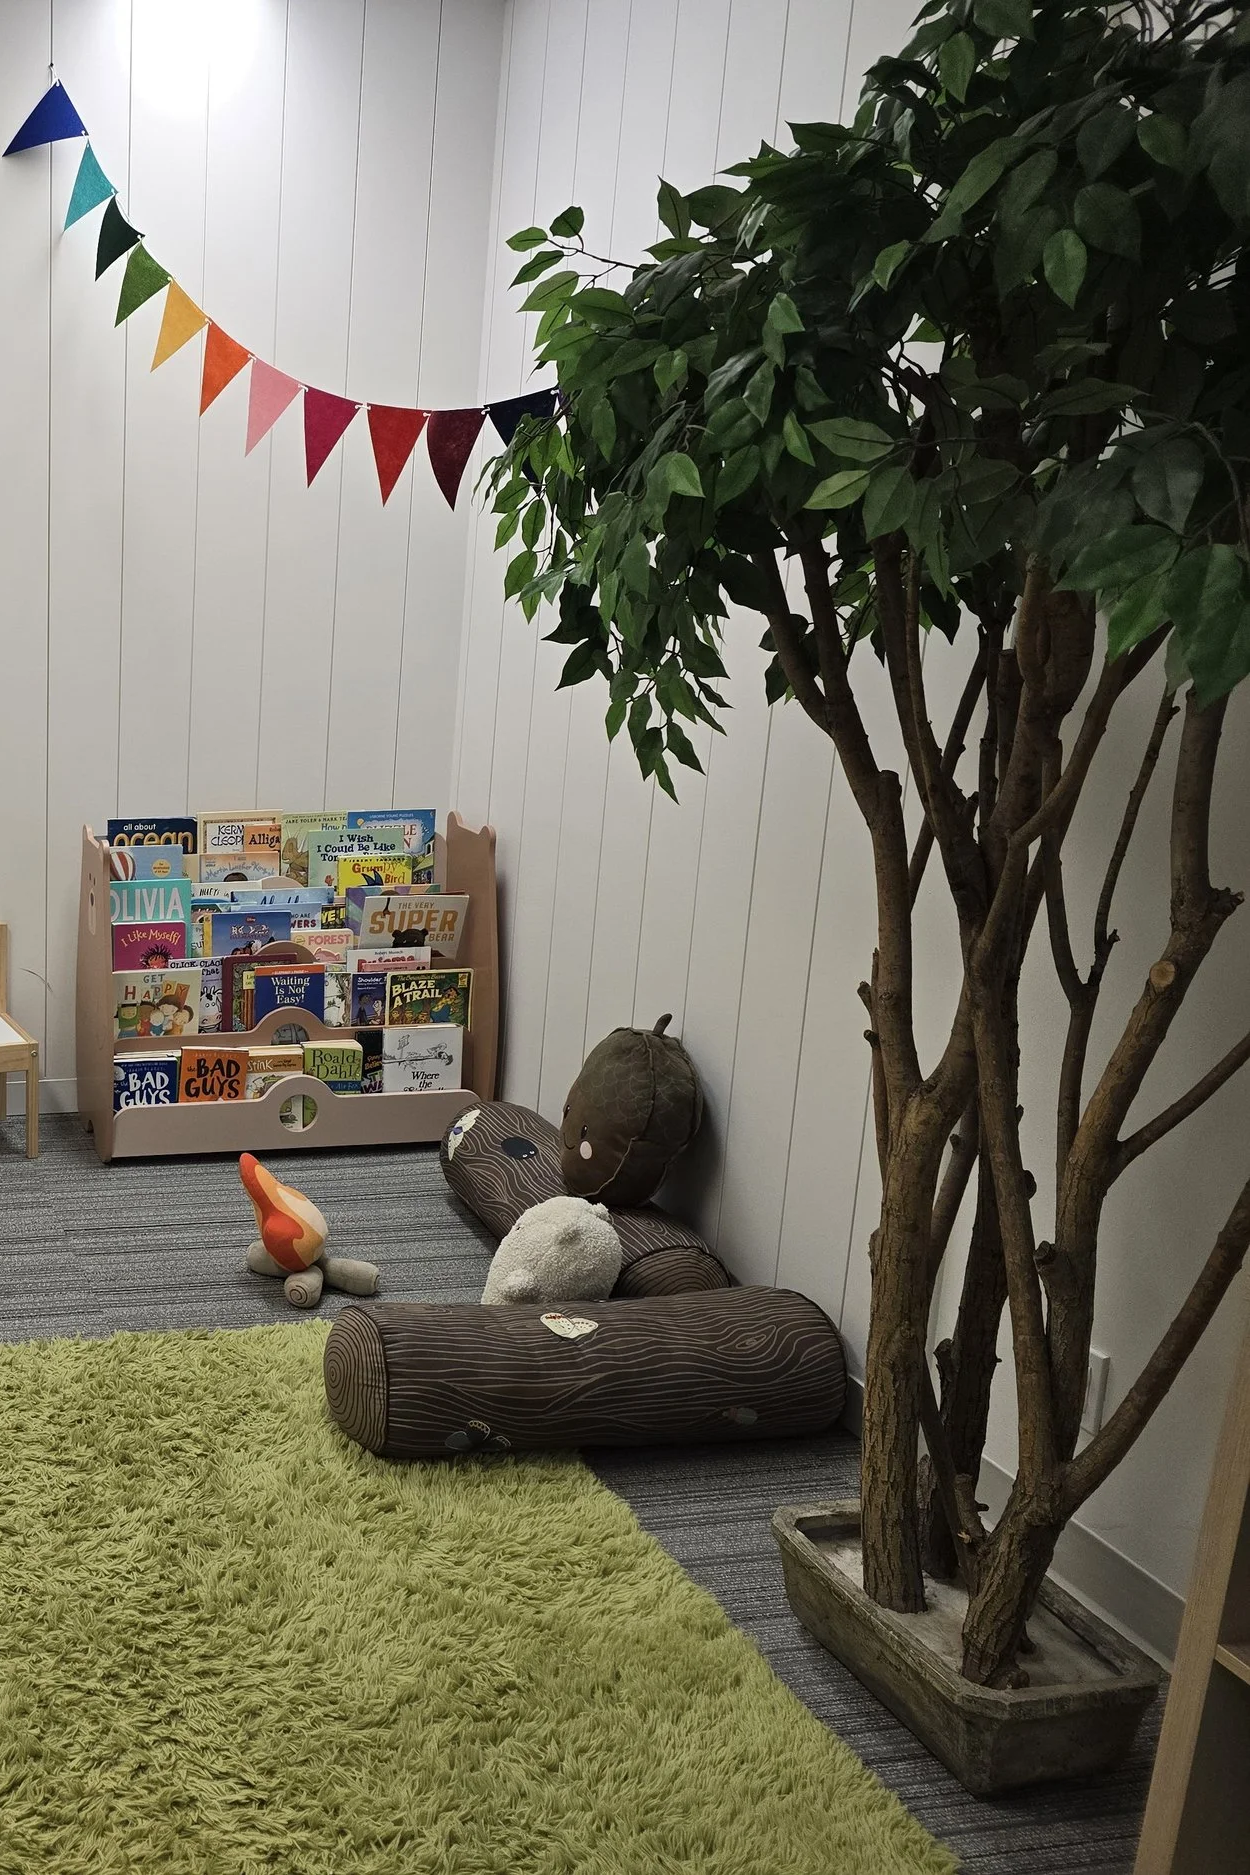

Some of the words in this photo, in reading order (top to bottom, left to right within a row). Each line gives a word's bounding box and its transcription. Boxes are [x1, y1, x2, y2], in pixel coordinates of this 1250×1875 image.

[114, 831, 194, 853] ocean
[347, 834, 374, 842] Wish
[324, 844, 354, 853] Could
[374, 843, 396, 851] Like
[352, 862, 396, 874] Grumpy
[384, 872, 406, 884] Bird
[370, 910, 459, 934] SUPER
[121, 938, 128, 947] I
[128, 930, 148, 942] Like
[148, 928, 181, 945] Myself!
[308, 934, 351, 945] FOREST
[430, 933, 454, 942] BEAR
[144, 974, 165, 984] GET
[271, 976, 310, 986] Waiting
[124, 984, 186, 1000] HAPPY
[276, 986, 284, 994] Is
[288, 986, 305, 994] Not
[392, 980, 436, 997] BLAZE
[277, 994, 305, 1005] Easy!
[392, 996, 402, 1010] A
[404, 989, 442, 1003] TRAIL
[312, 1049, 356, 1066] Roald
[197, 1058, 240, 1078] BAD
[316, 1064, 354, 1079] Dahl
[129, 1072, 170, 1092] BAD
[412, 1072, 440, 1080] Where
[185, 1076, 240, 1098] GUYS
[418, 1080, 432, 1088] the
[120, 1088, 170, 1108] GUYS
